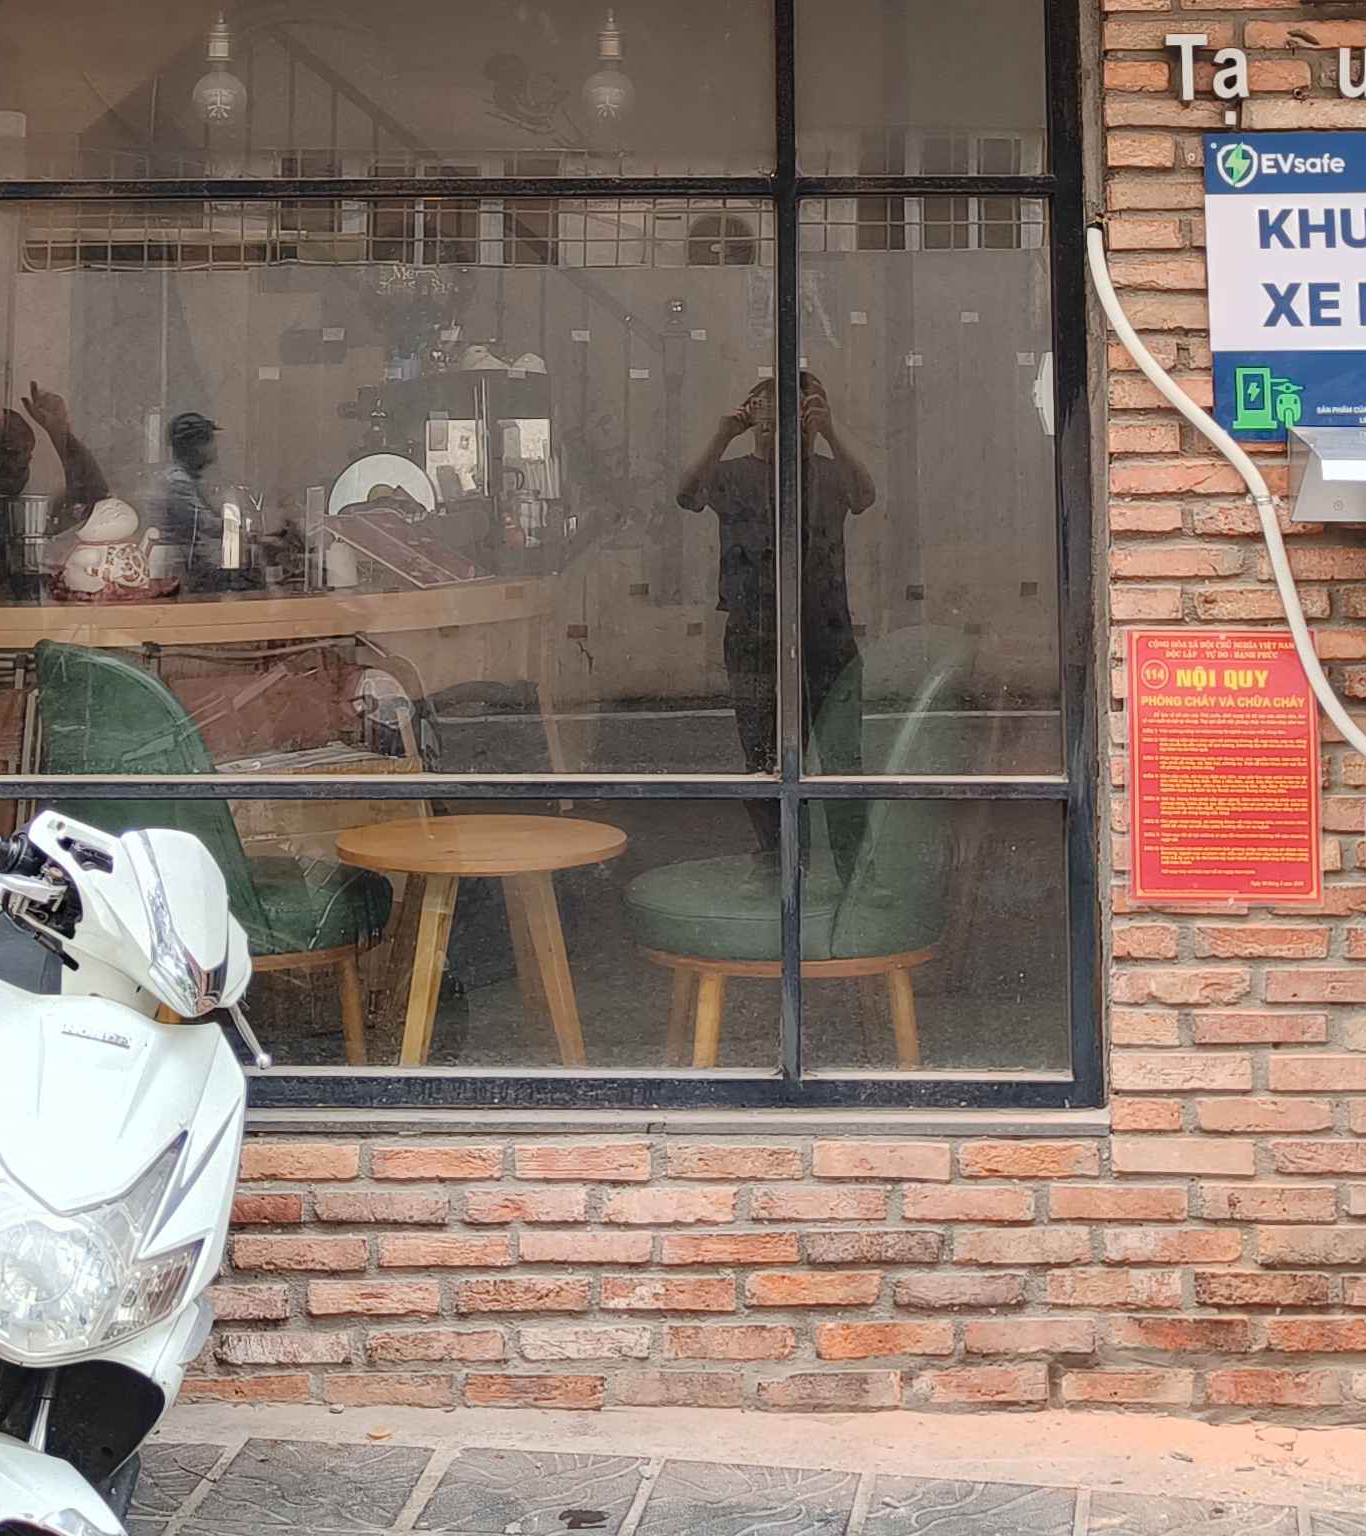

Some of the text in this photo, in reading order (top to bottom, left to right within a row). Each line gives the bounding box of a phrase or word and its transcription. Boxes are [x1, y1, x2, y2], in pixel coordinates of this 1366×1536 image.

[1165, 33, 1248, 126] Tạ
[1260, 153, 1346, 174] EVsafe
[1261, 282, 1342, 327] XE
[1144, 668, 1165, 681] 114
[1175, 666, 1269, 691] NỘI QUY
[1141, 693, 1306, 709] PHÒNG CHÁY VÀ CHỮA CHÁY
